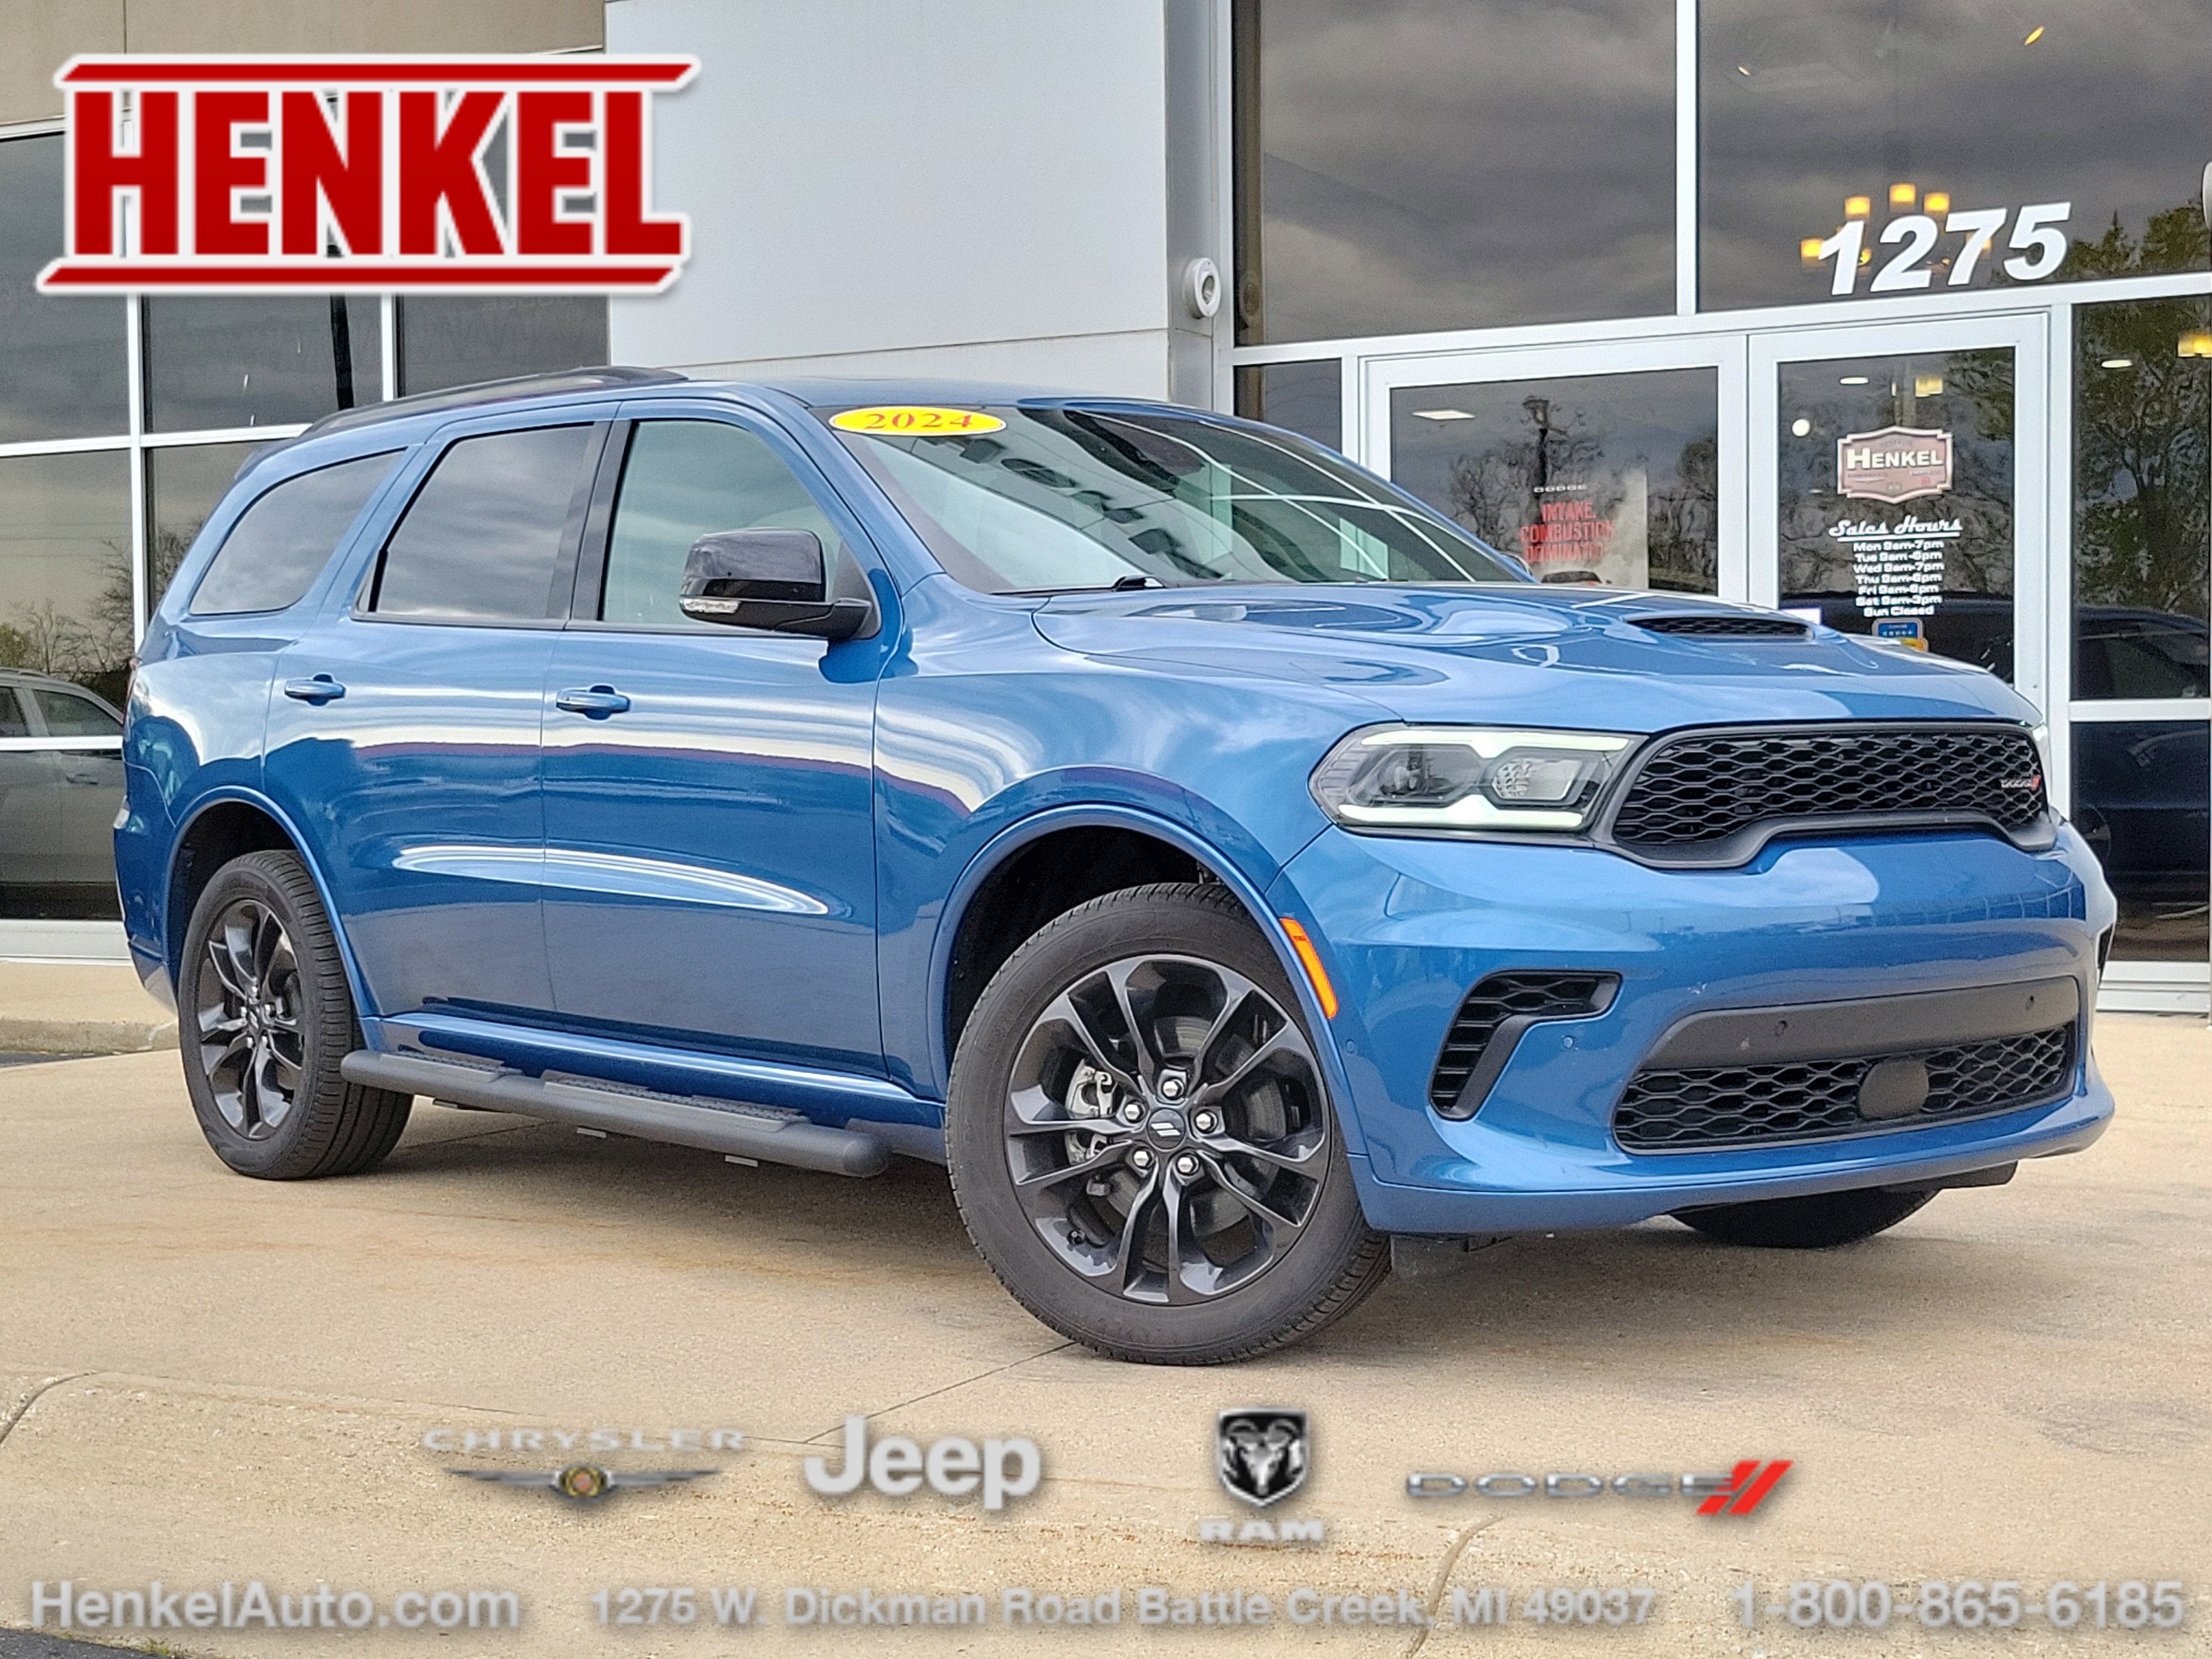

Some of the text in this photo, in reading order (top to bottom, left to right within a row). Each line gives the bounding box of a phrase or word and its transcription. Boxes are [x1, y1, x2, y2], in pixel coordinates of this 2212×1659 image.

[1818, 201, 2071, 296] 1275
[864, 412, 973, 430] 2024
[1846, 447, 1944, 470] HENKEL
[1828, 515, 1963, 537] Sales Hours
[1853, 543, 1881, 551] Mon
[1854, 554, 1877, 562] Tue
[1853, 564, 1882, 573] Wed
[1855, 575, 1879, 584] Thu
[1858, 585, 1877, 595] Fri
[1855, 596, 1879, 606] Sat
[1864, 605, 1934, 617] Sun Closed
